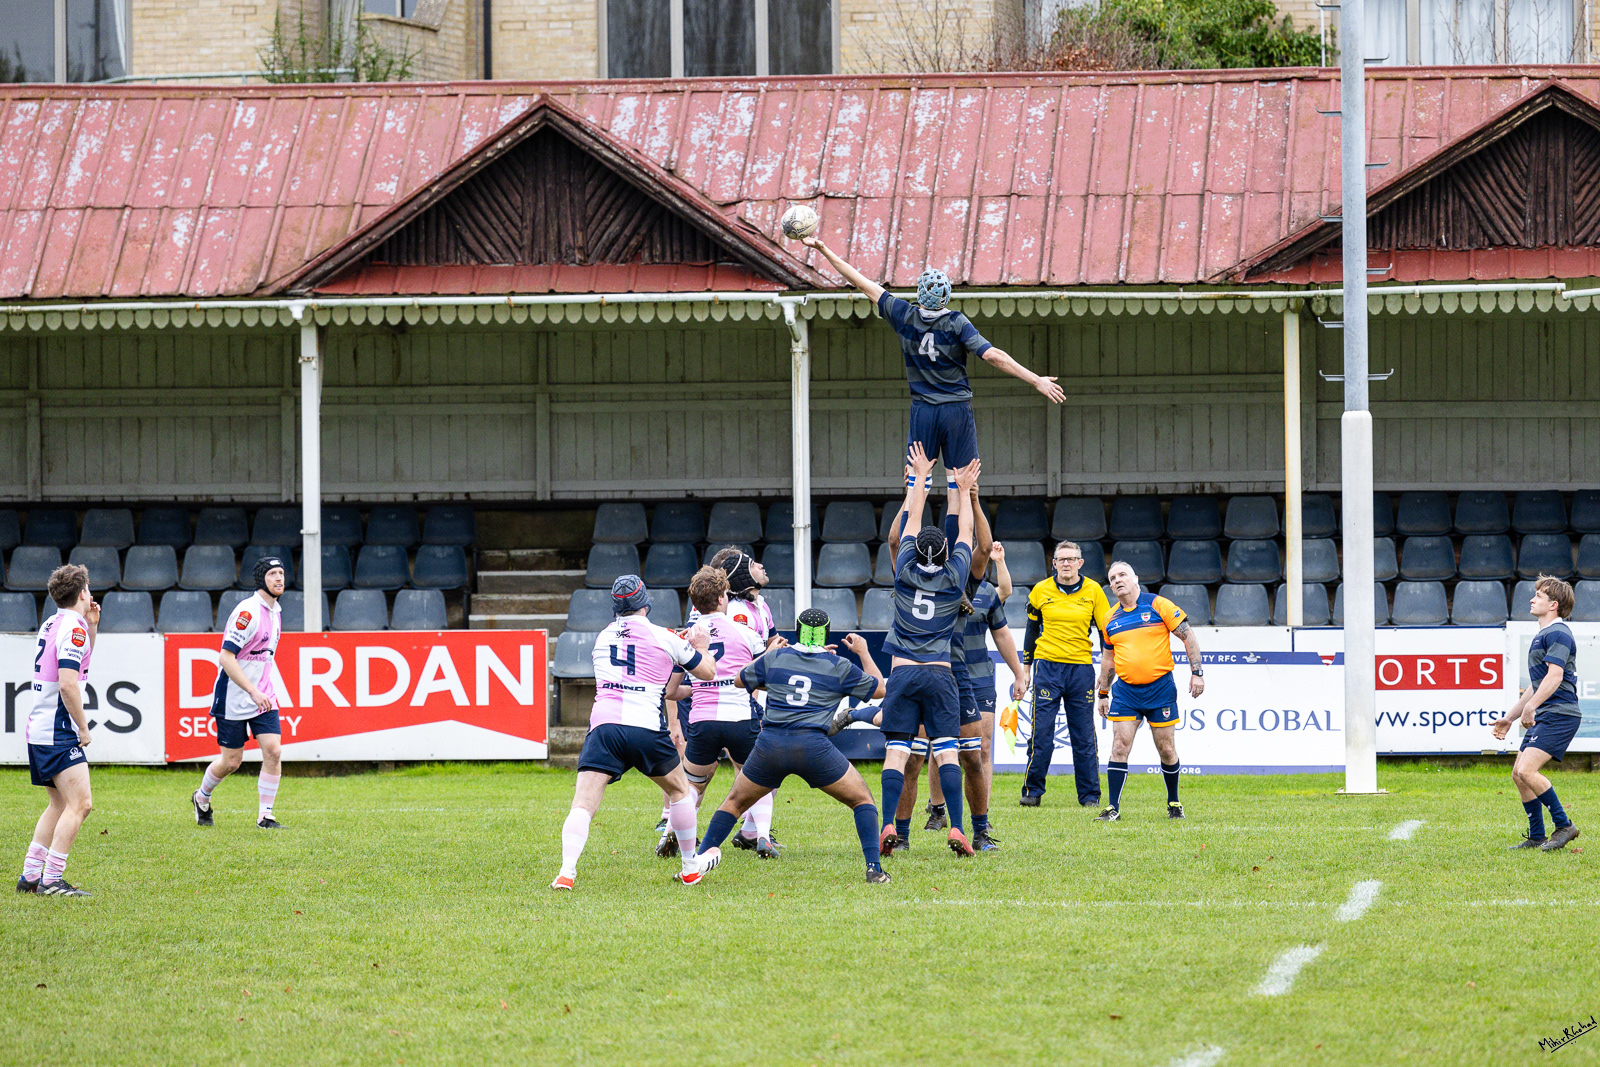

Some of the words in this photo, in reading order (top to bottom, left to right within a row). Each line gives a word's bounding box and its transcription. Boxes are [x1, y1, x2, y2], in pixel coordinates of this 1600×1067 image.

[919, 332, 940, 362] 4
[911, 589, 935, 620] 5
[609, 644, 636, 675] 4
[1217, 654, 1238, 663] RFC
[1378, 657, 1498, 686] ORTS
[179, 644, 535, 709] DRDAN
[785, 674, 812, 707] 3
[1216, 708, 1342, 732] GLOBAL
